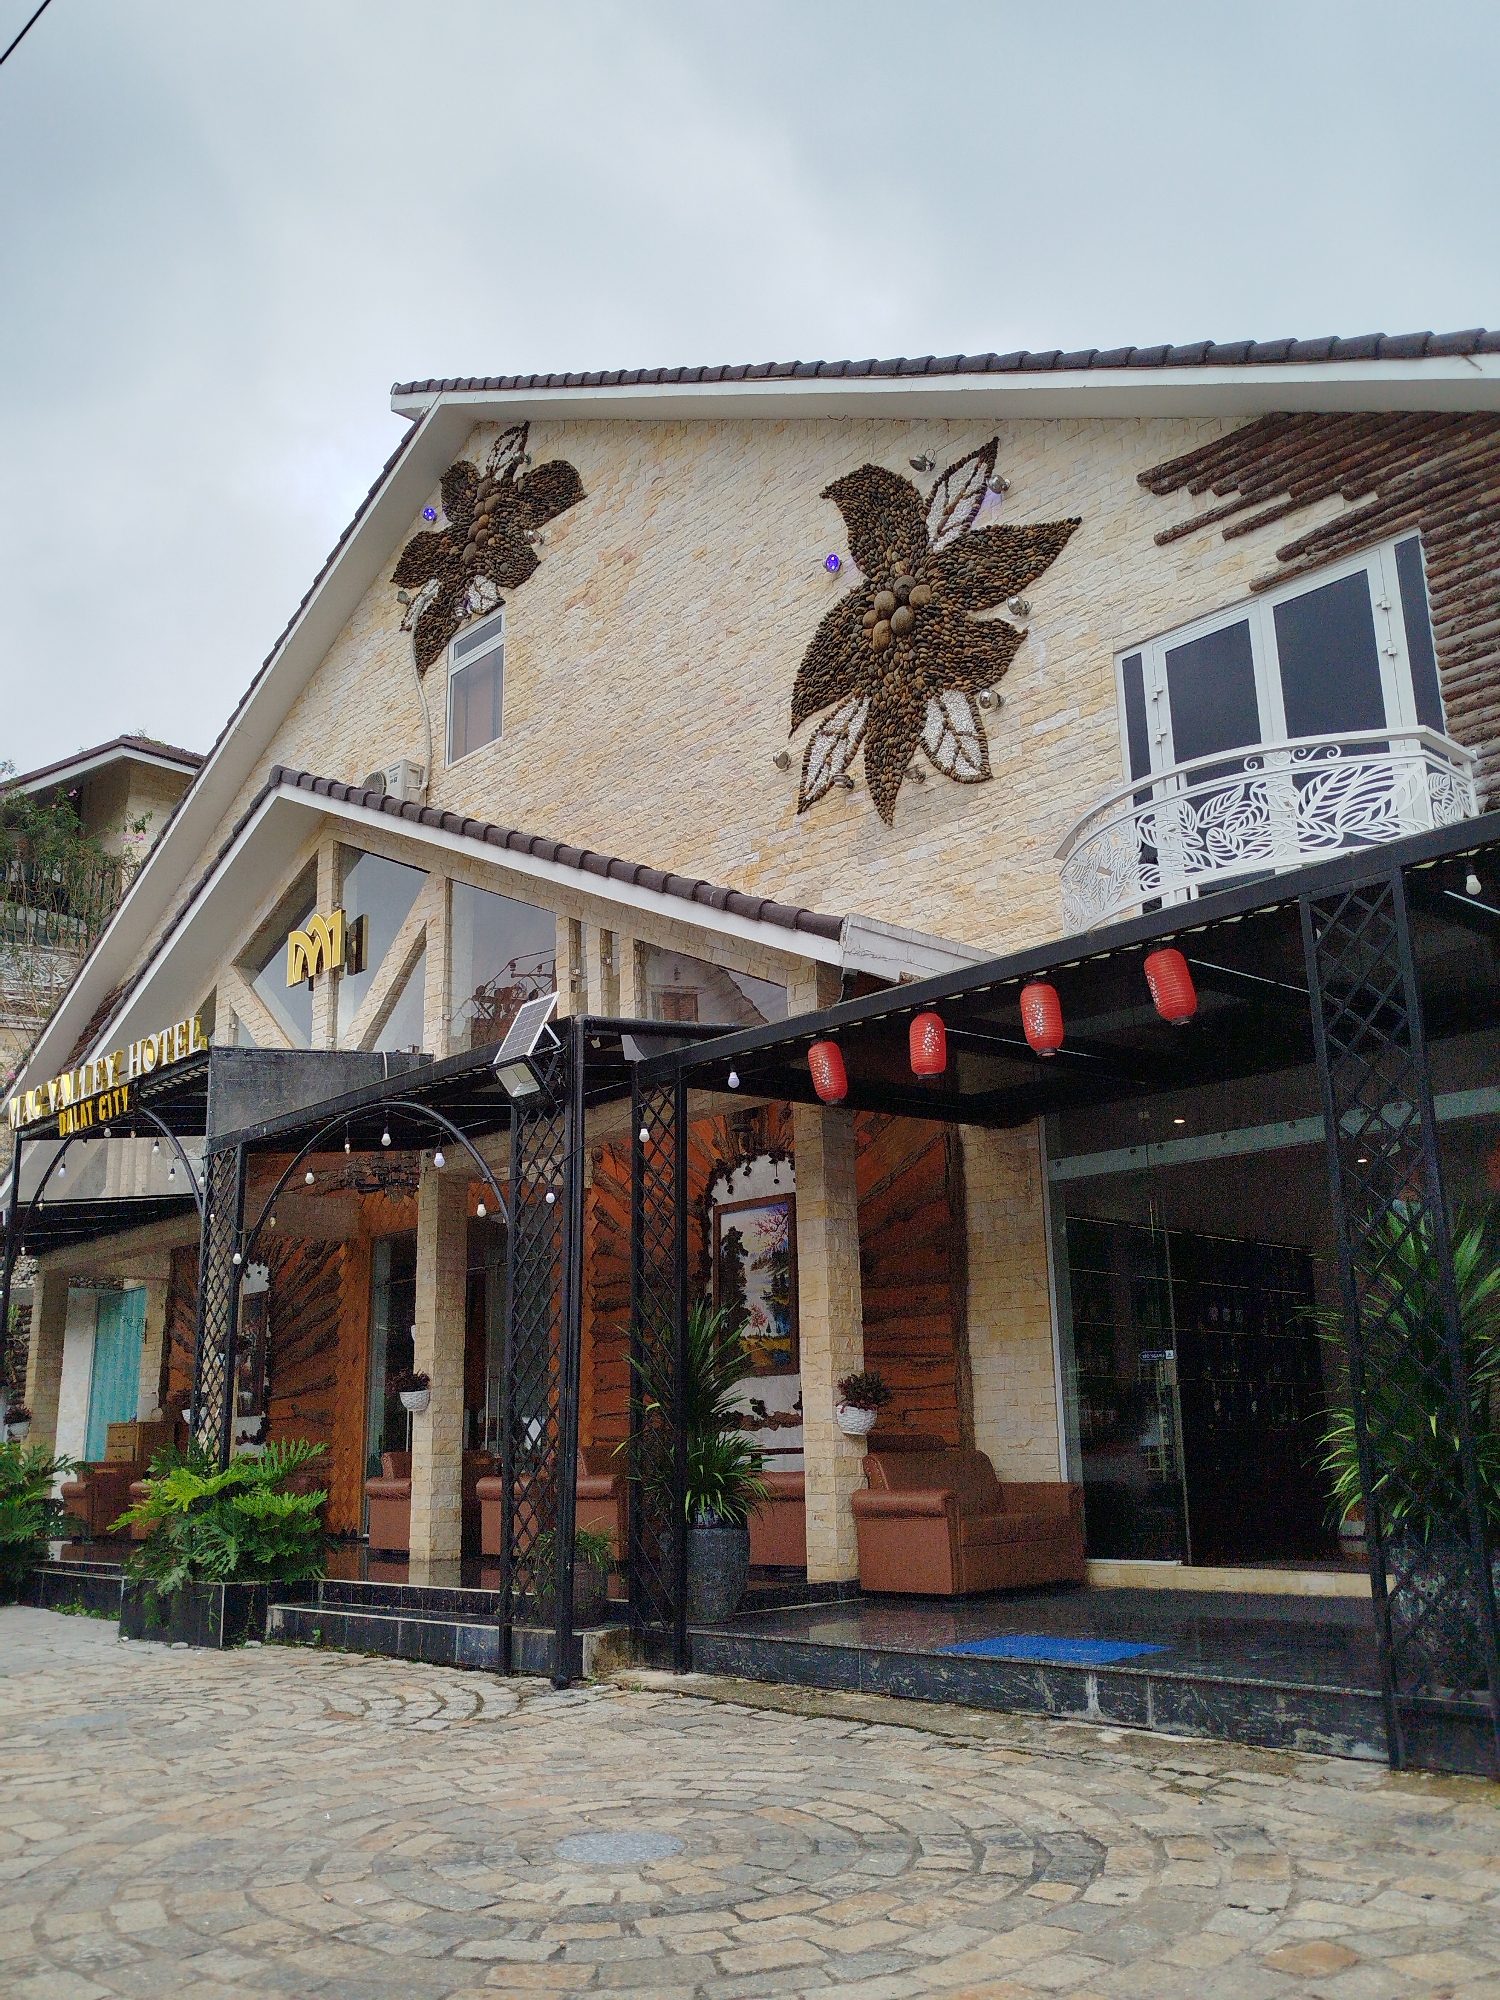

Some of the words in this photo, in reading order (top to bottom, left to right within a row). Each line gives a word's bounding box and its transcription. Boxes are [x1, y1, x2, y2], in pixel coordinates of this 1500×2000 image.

[47, 1050, 122, 1113] VALLEY
[127, 1016, 204, 1080] HOTEL
[58, 1100, 93, 1137] DALAT
[98, 1085, 129, 1121] CITY
